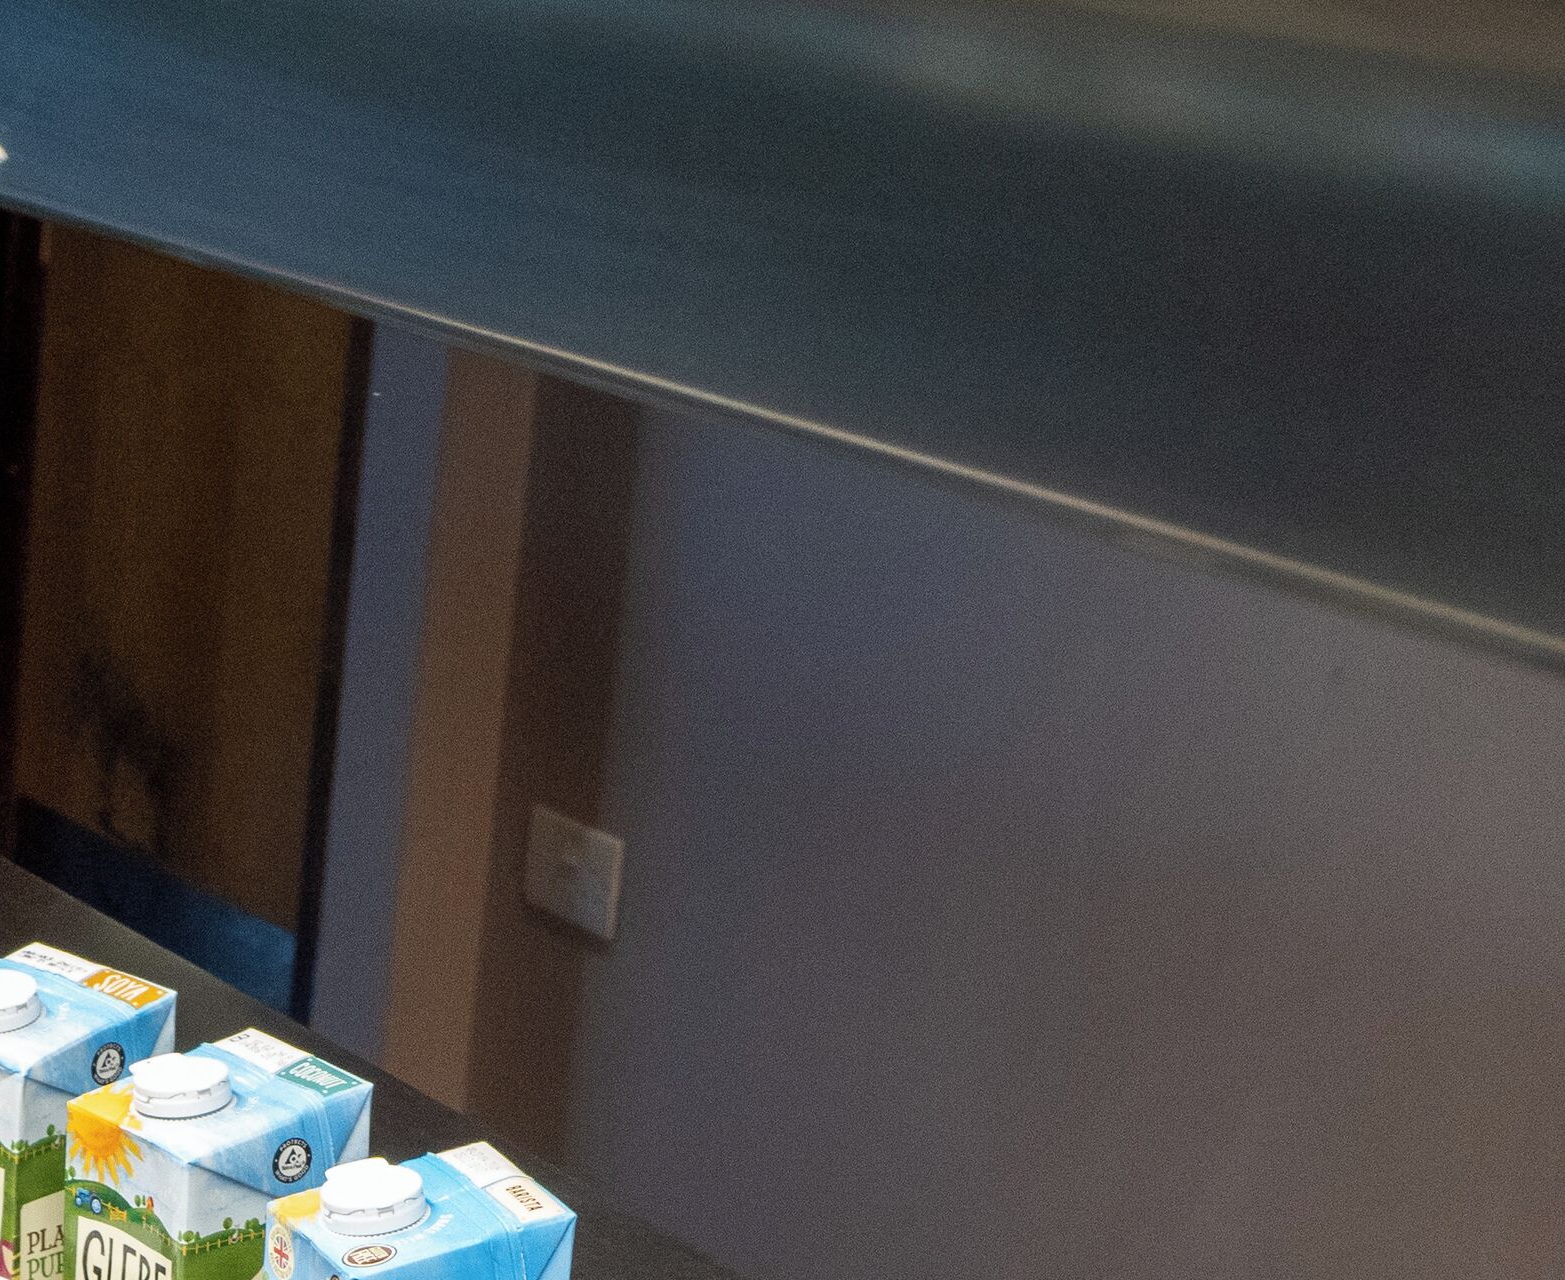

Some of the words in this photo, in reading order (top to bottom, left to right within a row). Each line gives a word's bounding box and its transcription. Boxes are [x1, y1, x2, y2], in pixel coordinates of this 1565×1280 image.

[94, 974, 149, 1001] SOYA
[289, 1062, 348, 1089] COCONUT
[505, 1184, 544, 1213] BARISTA
